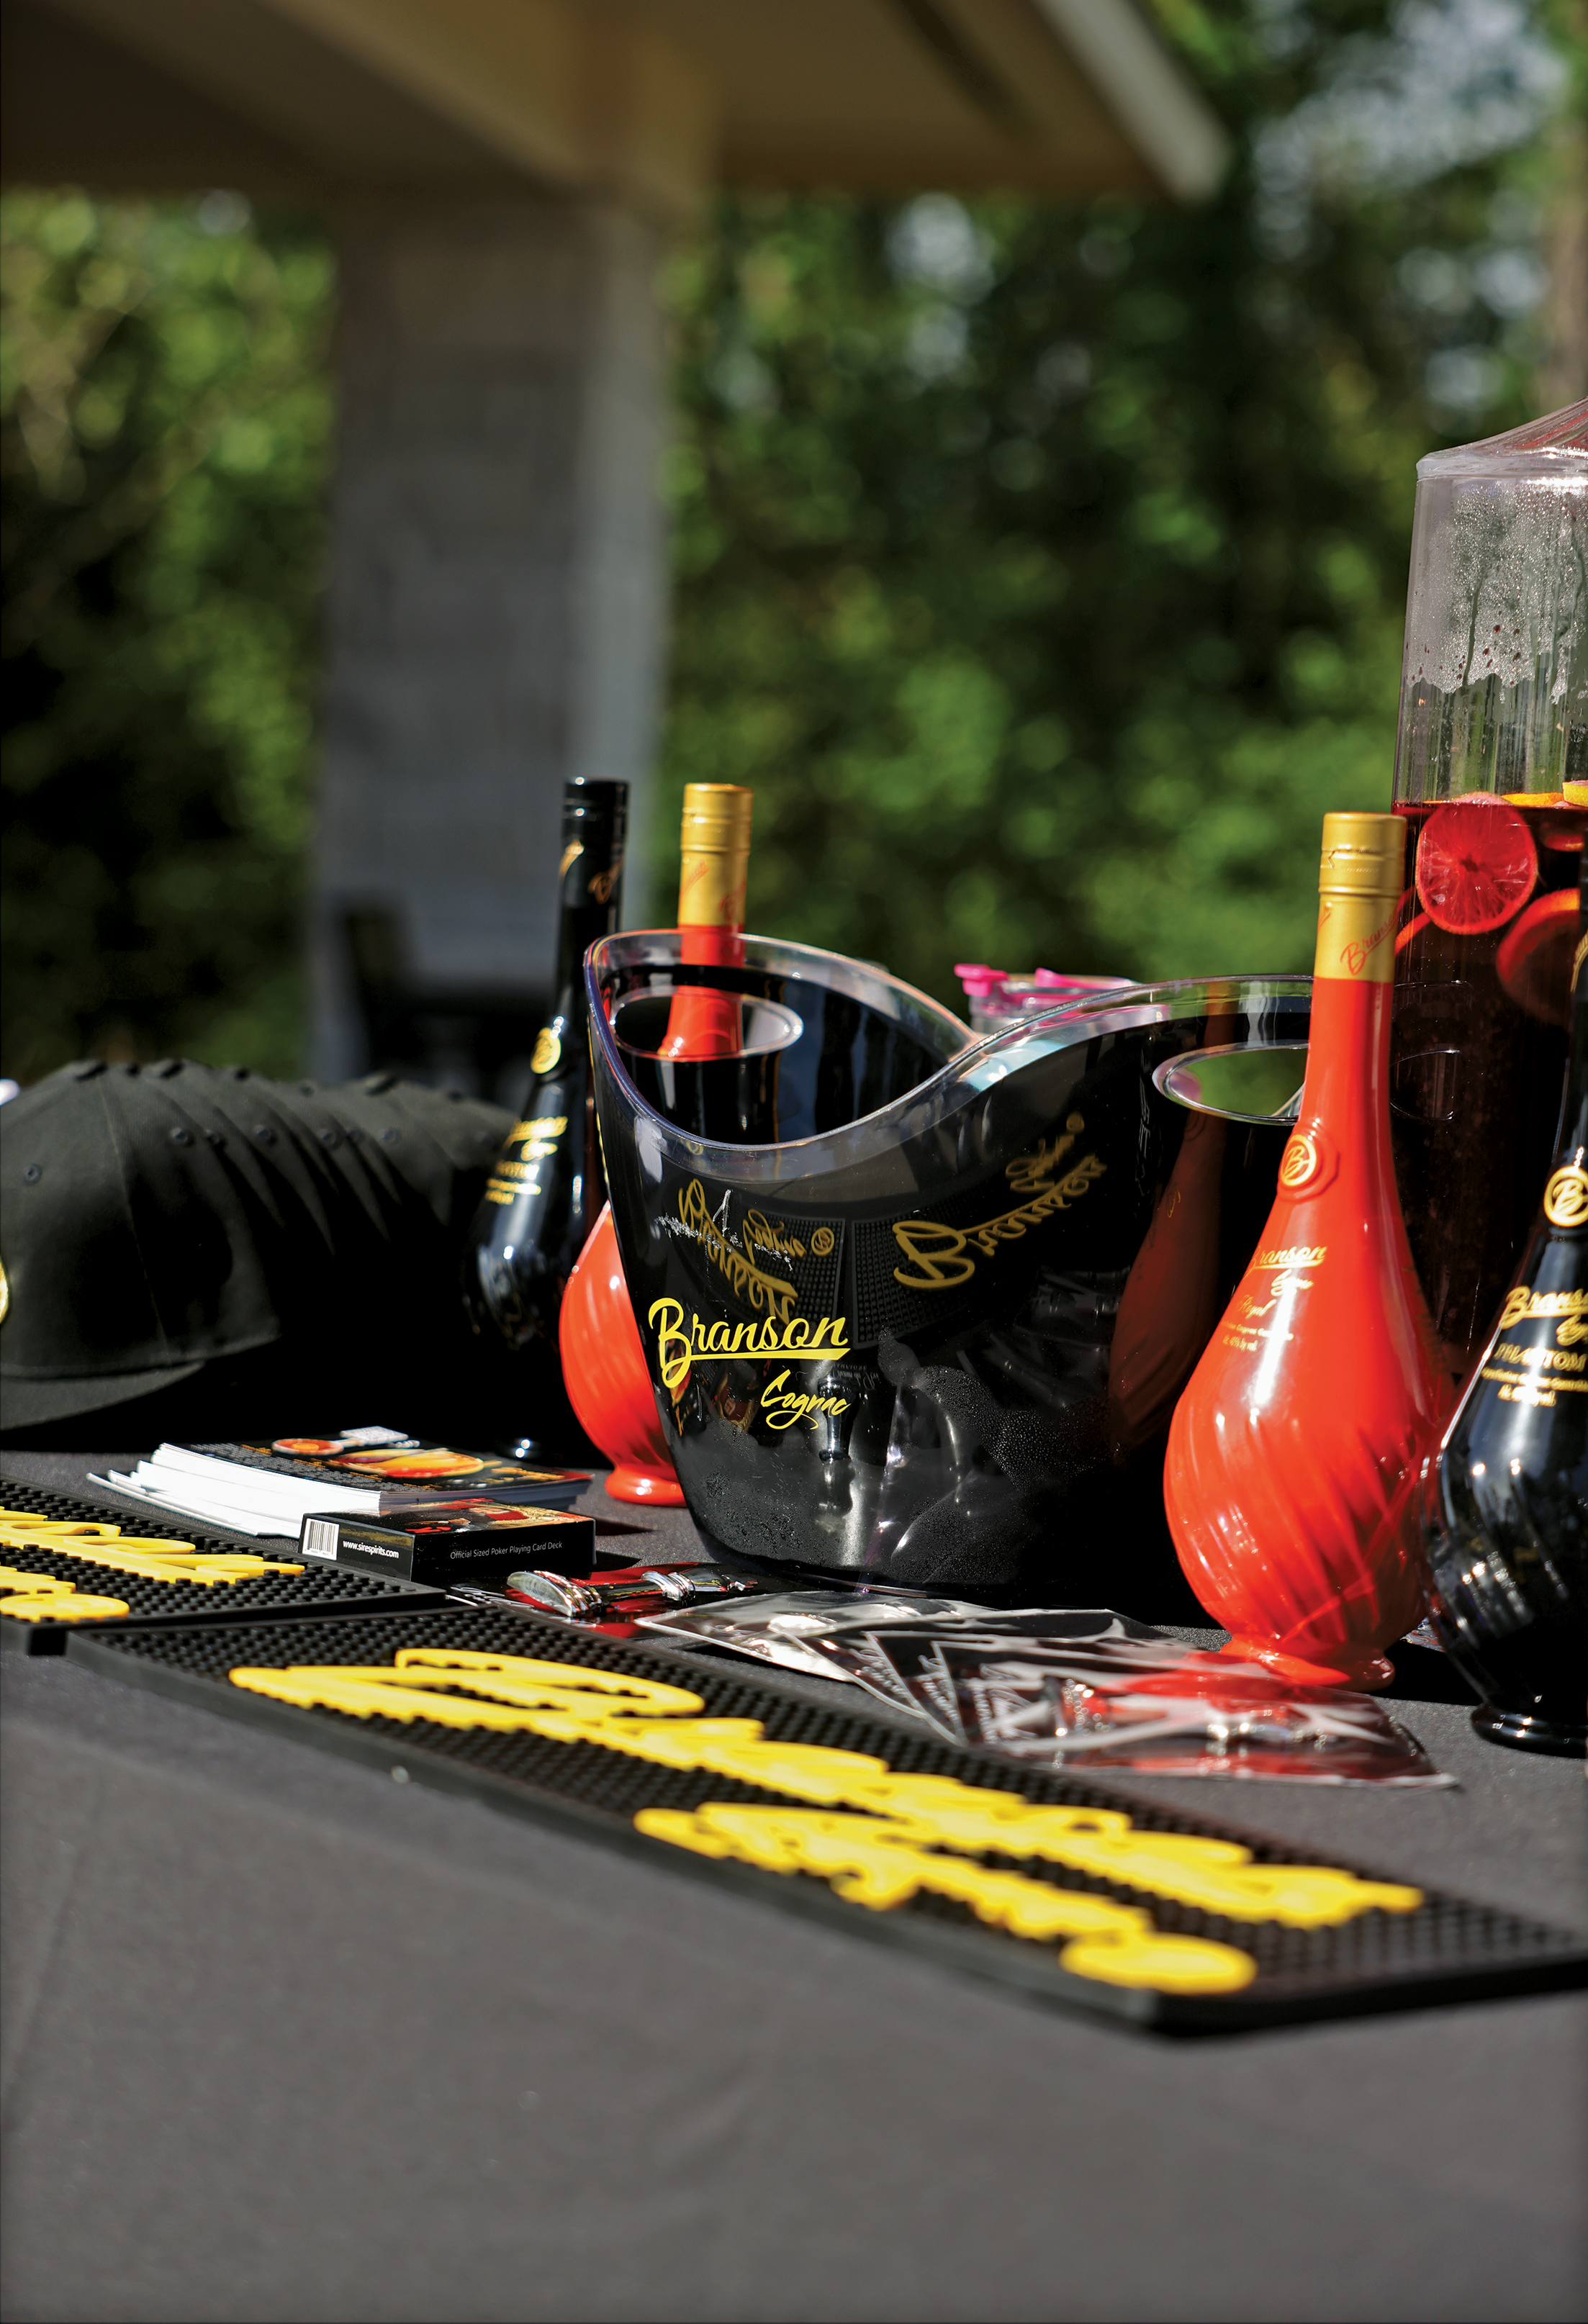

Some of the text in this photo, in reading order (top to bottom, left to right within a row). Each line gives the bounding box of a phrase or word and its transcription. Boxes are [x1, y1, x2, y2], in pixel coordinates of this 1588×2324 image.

[649, 1298, 851, 1388] Branson
[761, 1369, 852, 1429] Cognac
[343, 1540, 400, 1559] www.sirespirits.com
[450, 1541, 562, 1559] Official Sized Poker Playing Card Deck
